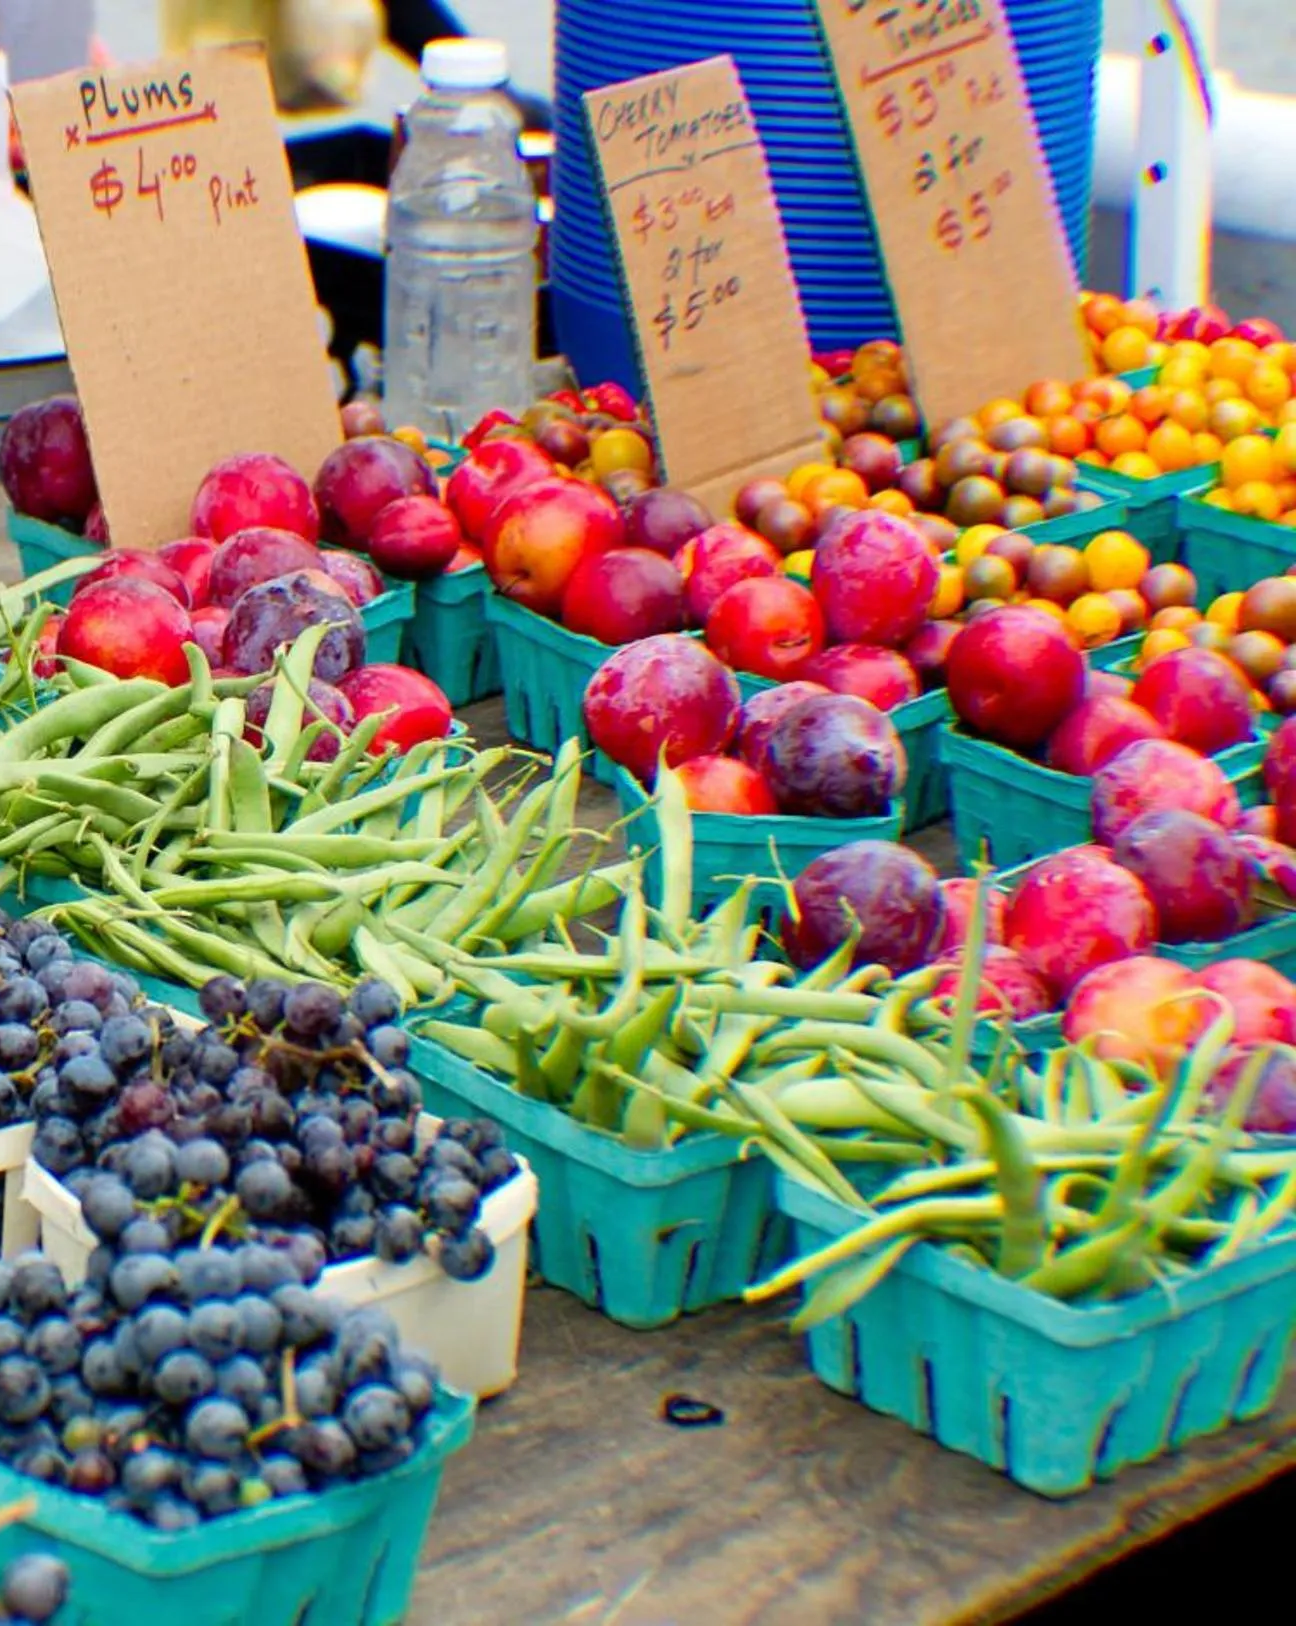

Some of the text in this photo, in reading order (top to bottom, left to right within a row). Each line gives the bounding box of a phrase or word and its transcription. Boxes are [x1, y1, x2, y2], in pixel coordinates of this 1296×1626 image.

[597, 80, 677, 141] CHERRY
[634, 101, 748, 159] TOMATOES
[662, 247, 682, 281] 2
